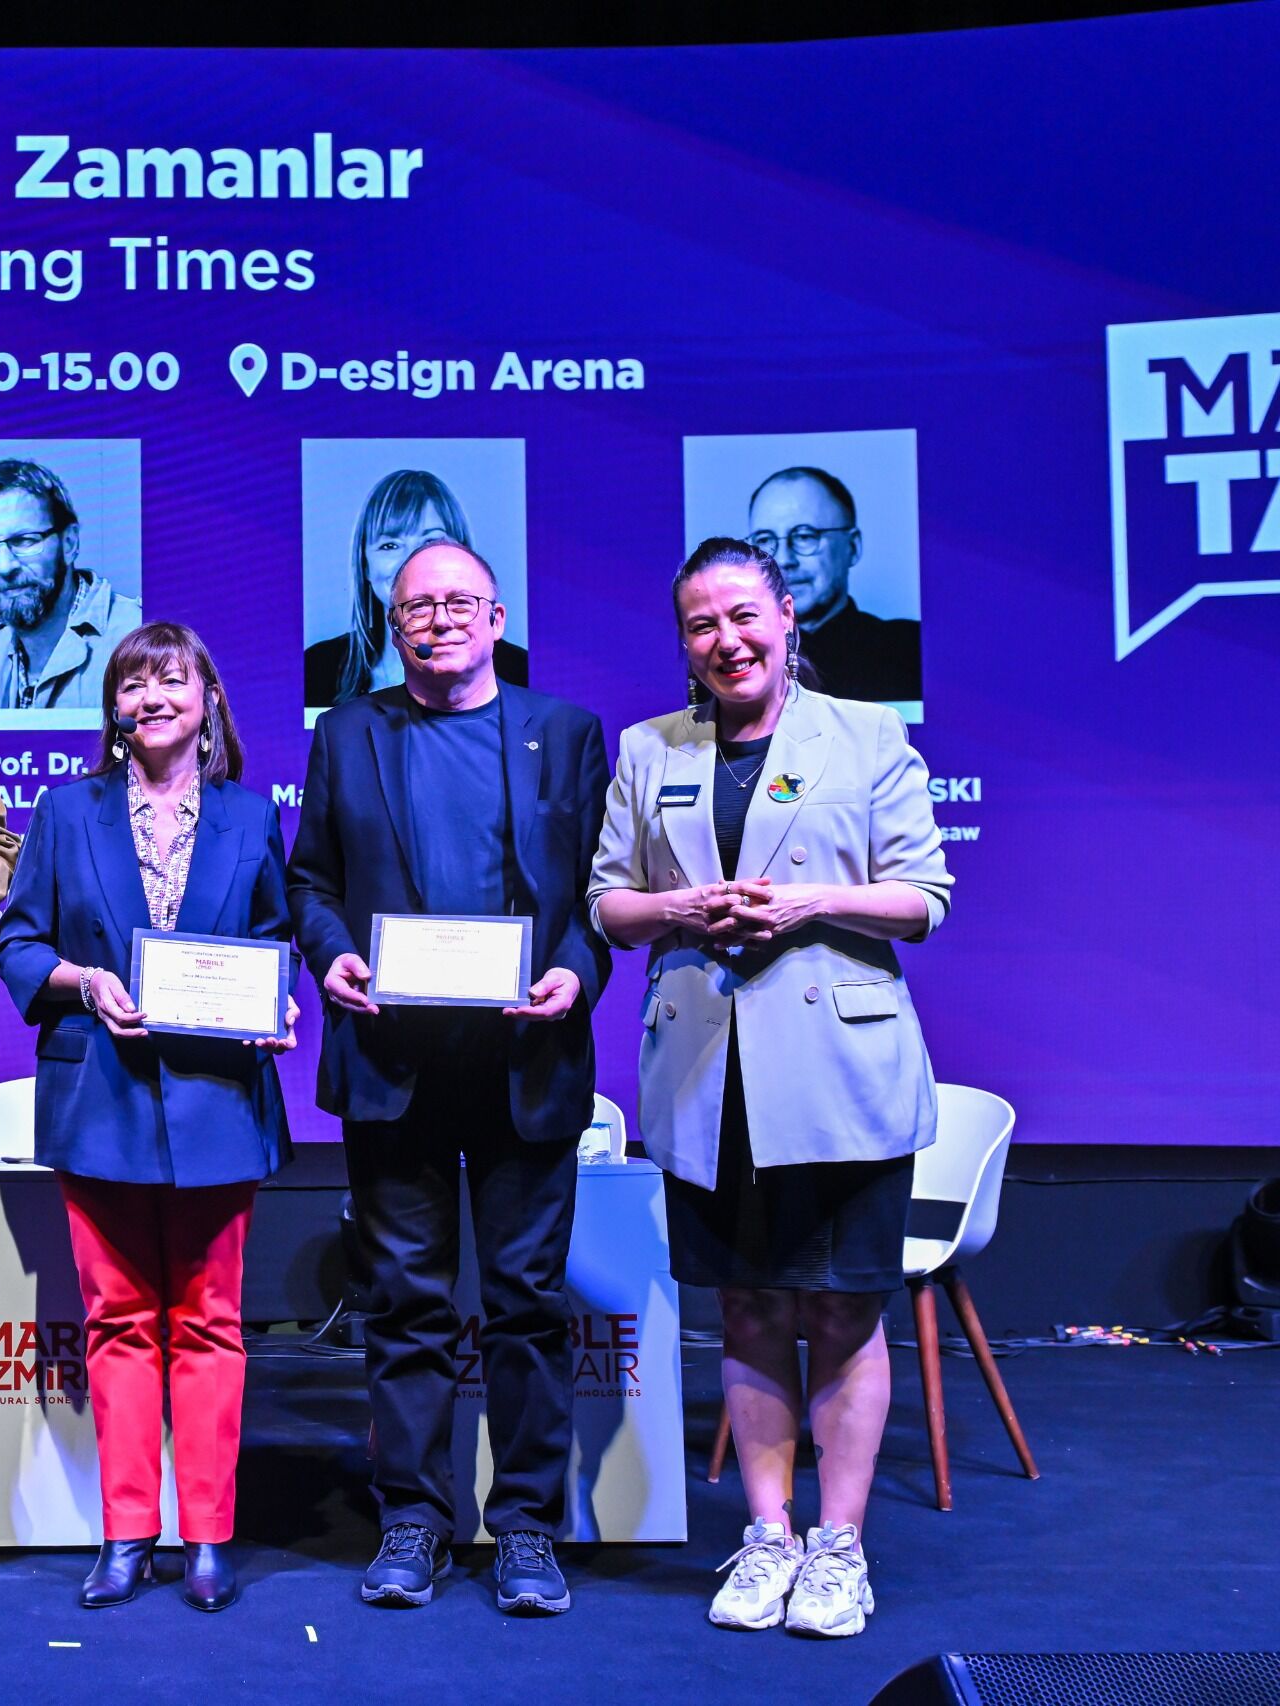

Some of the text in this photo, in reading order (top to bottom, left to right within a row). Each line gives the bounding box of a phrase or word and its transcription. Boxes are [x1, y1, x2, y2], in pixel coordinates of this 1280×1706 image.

[14, 132, 424, 200] Zamanlar
[109, 235, 316, 292] Times
[281, 351, 646, 399] D-esign Arena
[48, 752, 89, 776] Dr.
[928, 777, 982, 803] SKI
[941, 826, 981, 842] saw
[573, 1352, 641, 1384] AIR
[34, 1396, 72, 1405] STONE
